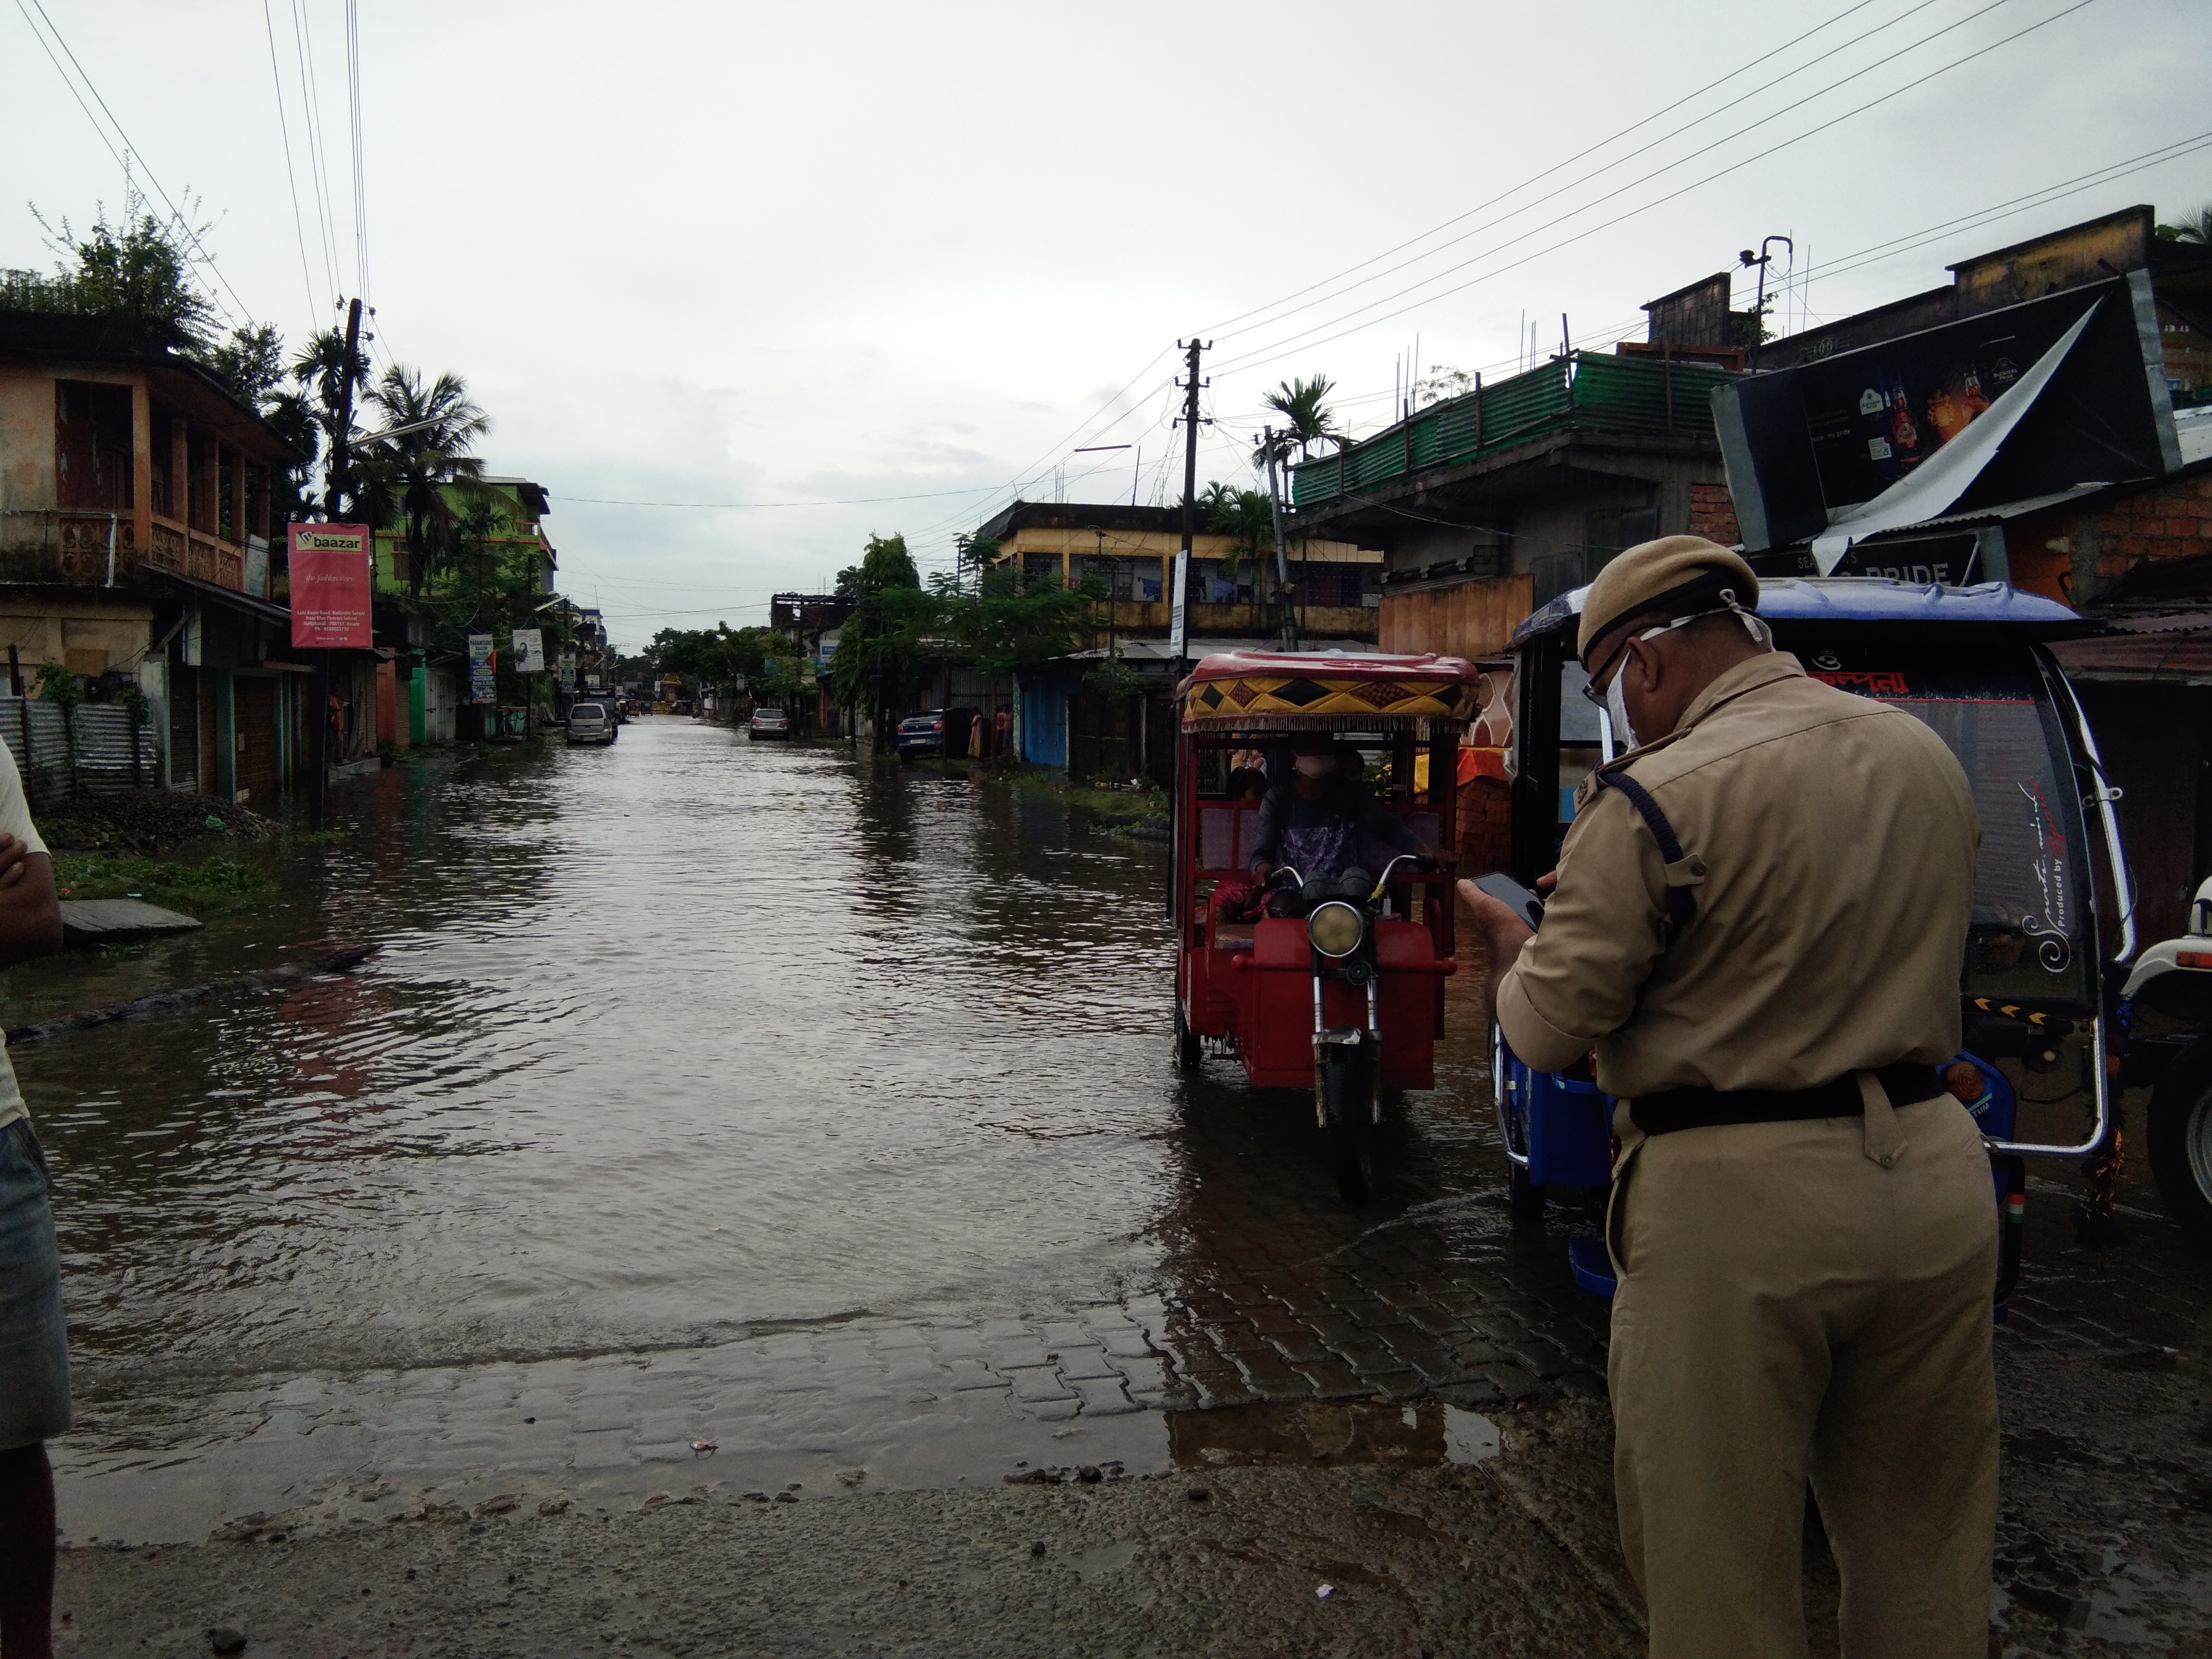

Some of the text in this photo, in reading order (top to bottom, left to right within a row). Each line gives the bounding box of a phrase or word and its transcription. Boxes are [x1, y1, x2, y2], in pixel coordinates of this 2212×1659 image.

[314, 537, 360, 548] baazar
[315, 574, 339, 583] fashion
[2053, 859, 2063, 873] by
[2054, 875, 2065, 927] Produced
